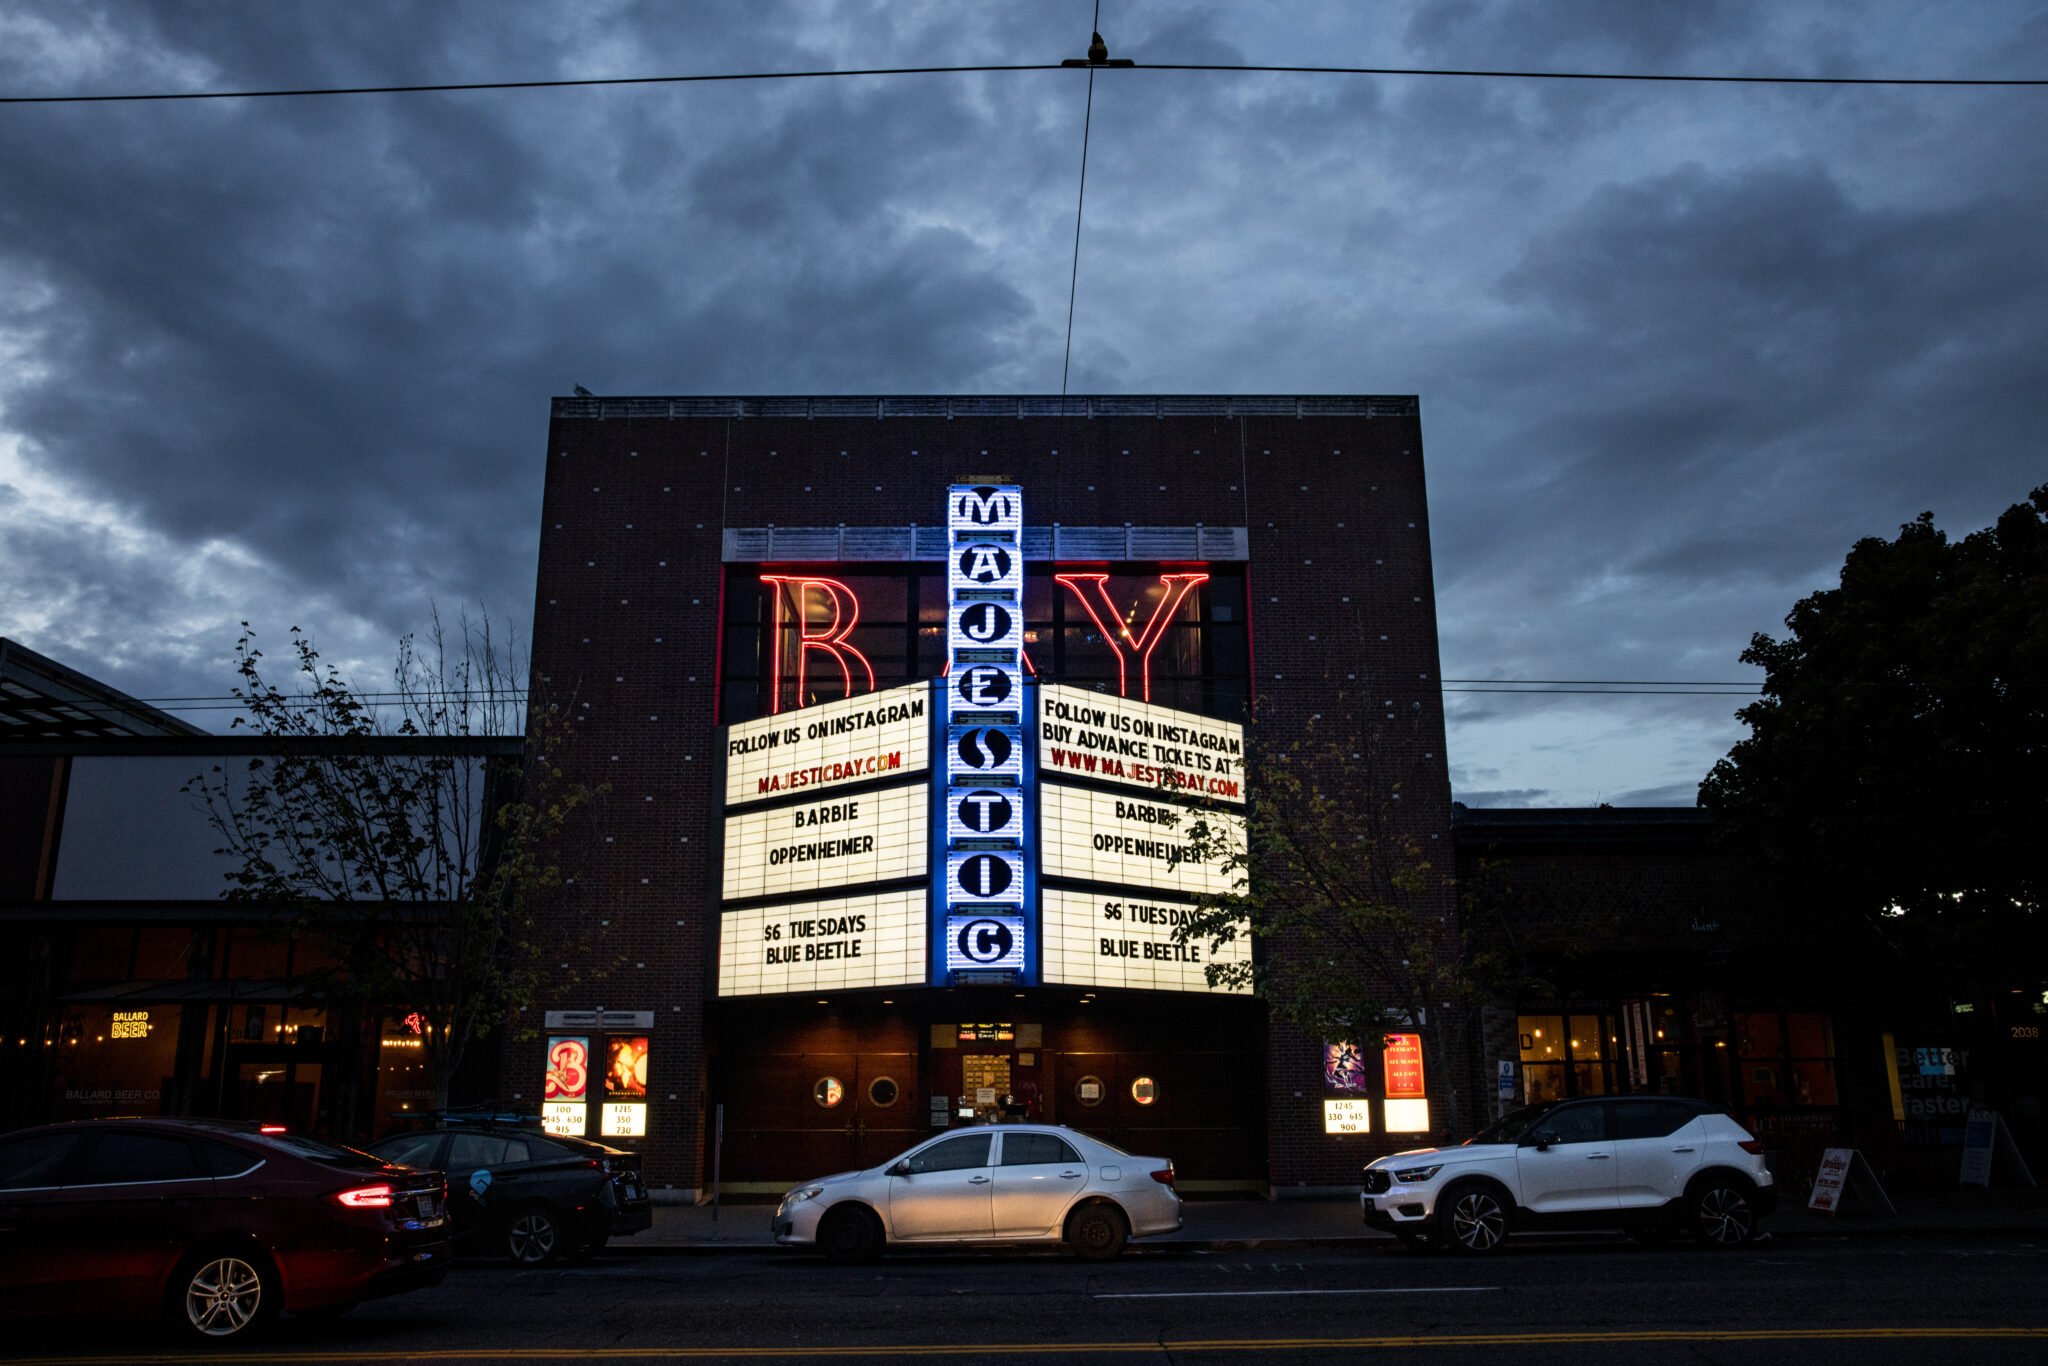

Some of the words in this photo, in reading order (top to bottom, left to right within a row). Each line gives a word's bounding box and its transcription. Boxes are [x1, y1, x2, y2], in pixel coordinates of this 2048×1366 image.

[758, 572, 1210, 712] BY
[729, 731, 780, 757] FOLLOW
[783, 727, 801, 746] US
[830, 699, 924, 736] INSTAGRAM
[958, 488, 1012, 962] MAJESTIC
[1045, 699, 1106, 728] FOLLOW
[1110, 713, 1130, 733] US
[1133, 719, 1155, 738] ON
[1157, 723, 1241, 755] INSTAGRAM
[1042, 723, 1072, 744] BUY
[1077, 730, 1148, 760] ADVANCE
[1153, 744, 1212, 771] TICKETS
[1215, 758, 1232, 775] AT
[758, 750, 902, 794] MAJESTICBAY.COM
[795, 802, 859, 828] BARBIE
[770, 835, 874, 866] OPPENHEIMER
[1093, 833, 1201, 864] OPPENHEIMER
[1104, 902, 1122, 920] $6
[764, 924, 781, 942] $6
[790, 914, 867, 939] TUESDAYS
[766, 945, 801, 965] BLUE
[805, 940, 862, 962] BEETLE
[1100, 938, 1139, 958] BLUE
[1143, 942, 1201, 963] BEETLE
[113, 1011, 149, 1022] BALLARD
[111, 1022, 148, 1039] BEER
[2011, 1026, 2040, 1038] 2038
[1896, 1047, 1970, 1068] Better
[1899, 1072, 1958, 1093] care,
[65, 1090, 113, 1100] BALLARD
[114, 1090, 143, 1100] BEER
[1903, 1093, 1970, 1115] faster
[556, 1105, 571, 1114] 100
[614, 1104, 632, 1113] 1215
[1327, 1113, 1343, 1121] 330
[1349, 1112, 1363, 1121] 615
[1335, 1102, 1353, 1110] 1245
[555, 1125, 570, 1134] 915
[567, 1115, 582, 1124] 630
[616, 1115, 631, 1124] 350
[1340, 1123, 1357, 1131] 900
[616, 1126, 631, 1135] 730
